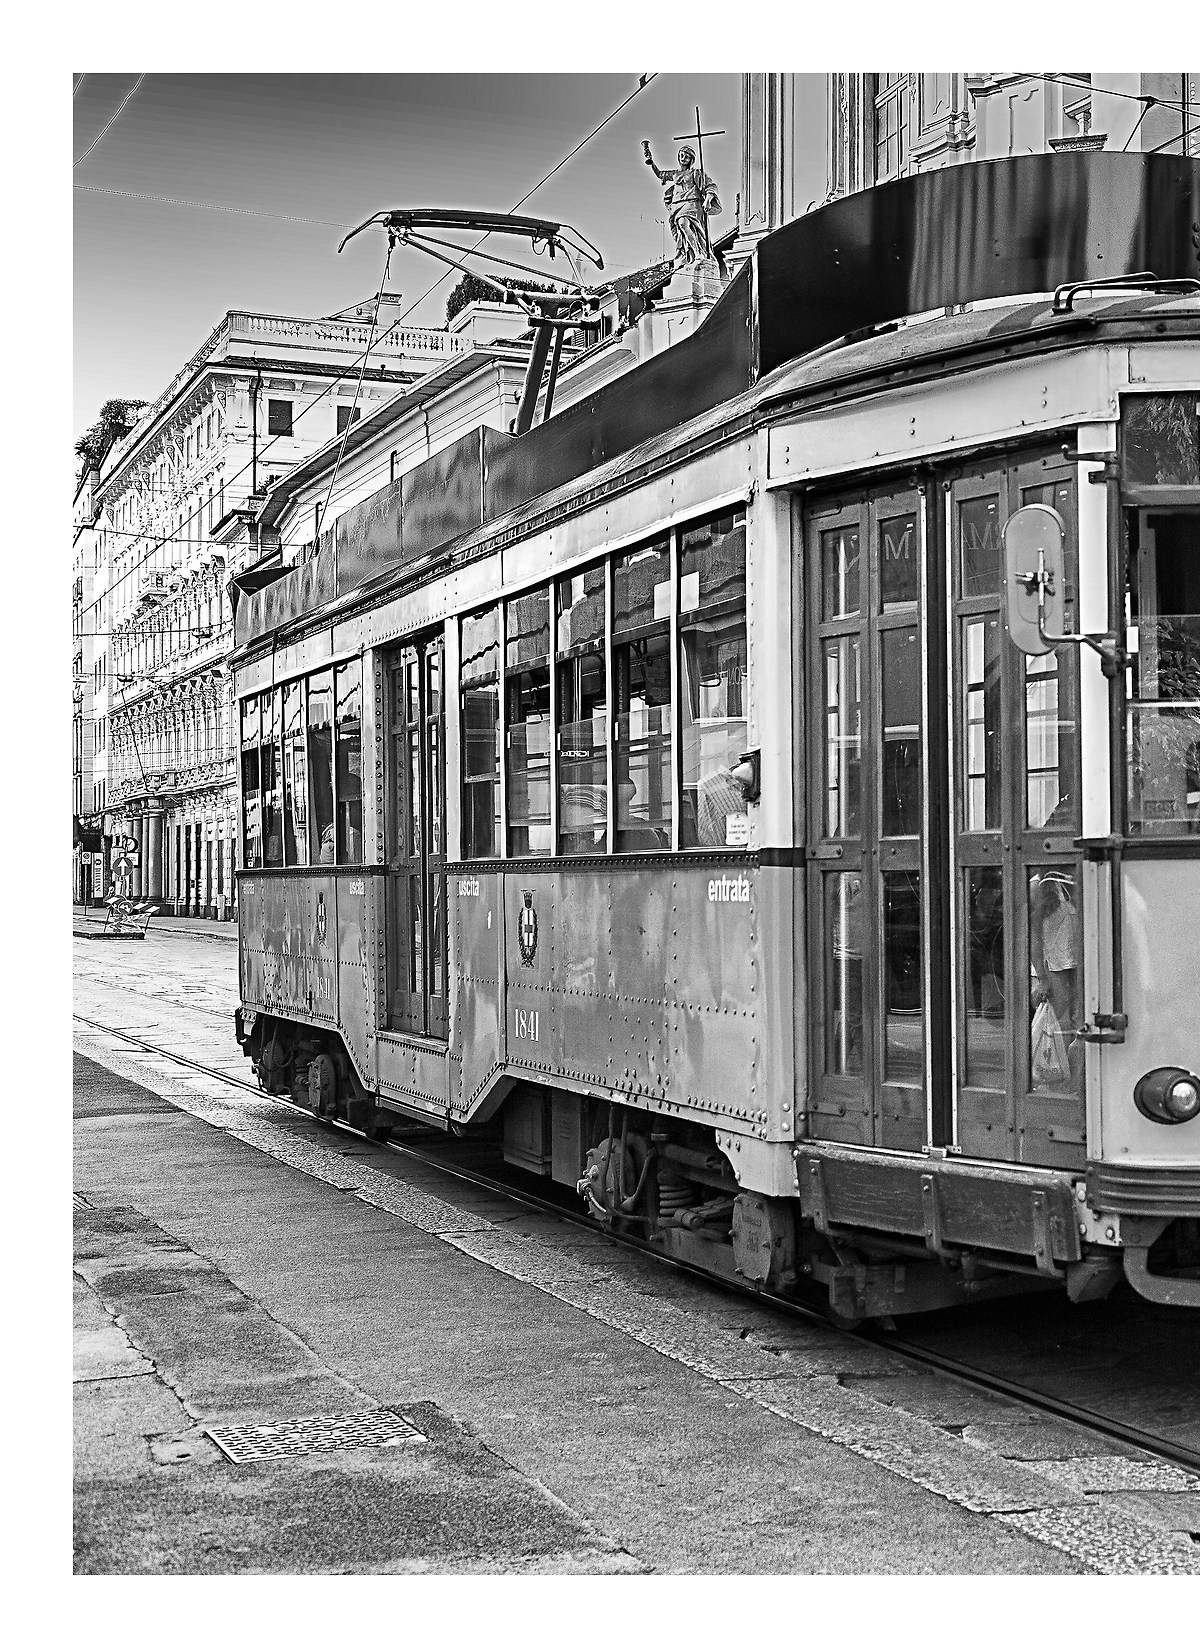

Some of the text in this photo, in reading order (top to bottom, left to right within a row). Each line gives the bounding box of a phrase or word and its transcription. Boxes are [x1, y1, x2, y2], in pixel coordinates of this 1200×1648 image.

[458, 876, 479, 897] uscita
[708, 873, 750, 902] entrata
[515, 1008, 540, 1042] 1841
